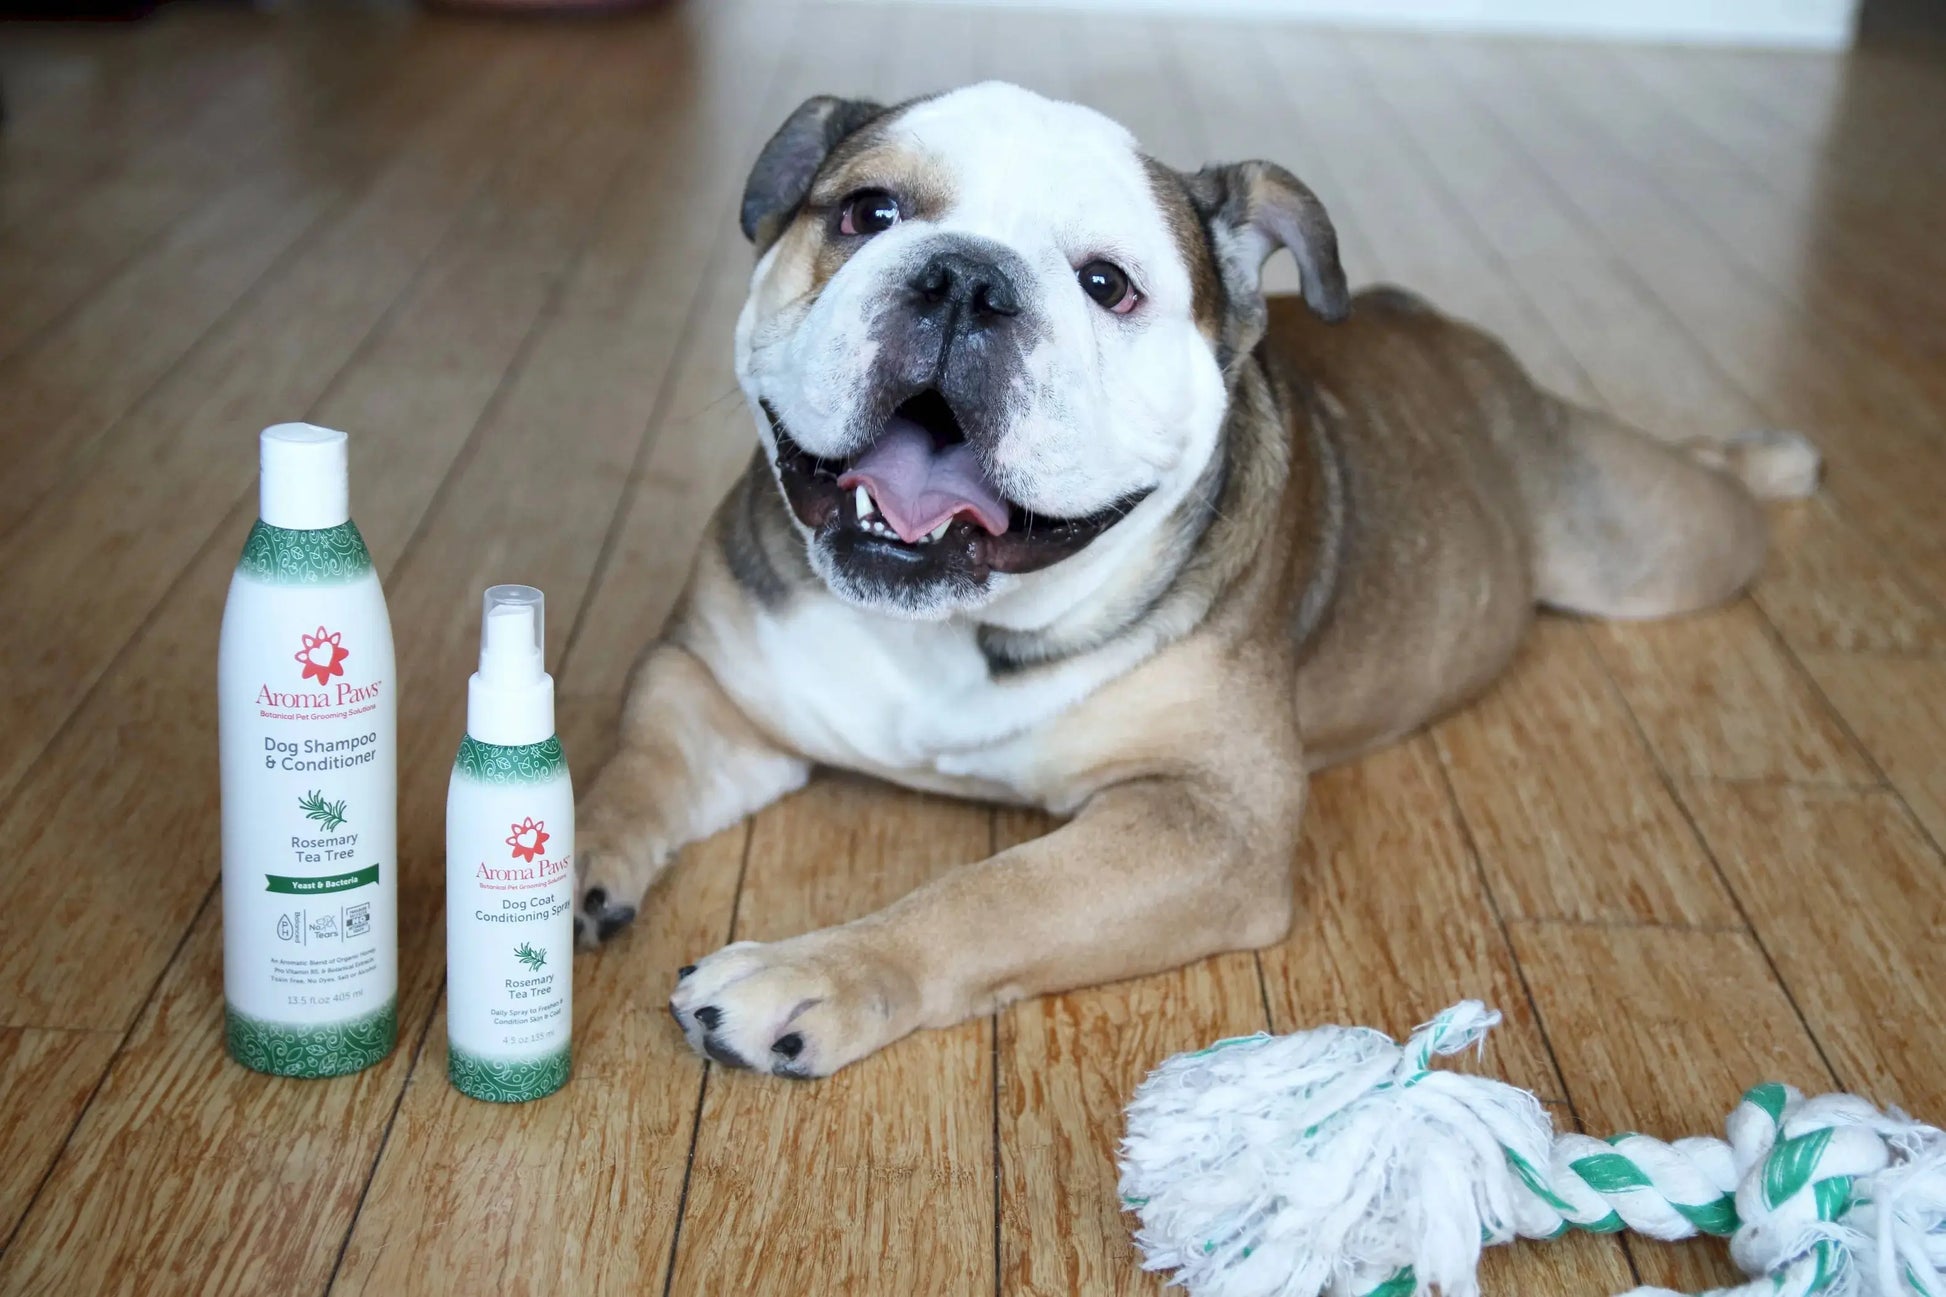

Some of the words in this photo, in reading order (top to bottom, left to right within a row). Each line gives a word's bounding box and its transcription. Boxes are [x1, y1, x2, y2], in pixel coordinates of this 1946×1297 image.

[256, 683, 331, 708] Aroma
[260, 710, 295, 720] Botanical
[311, 711, 348, 720] Grooming
[265, 737, 298, 757] Dog
[304, 732, 377, 753] Shampoo
[266, 755, 276, 769] &
[281, 749, 376, 771] Conditioner
[291, 834, 358, 848] Rosemary
[296, 851, 320, 863] Tea
[325, 849, 354, 861] Tree
[476, 862, 534, 881] Aroma
[292, 881, 316, 889] Yeast
[325, 876, 359, 888] Bacteria
[519, 881, 547, 890] Grooming
[502, 900, 527, 910] Dog
[530, 894, 554, 907] Coat
[475, 911, 549, 922] Conditioning
[551, 898, 571, 916] Spray
[314, 931, 338, 939] Tears
[505, 974, 554, 988] Rosemary
[509, 990, 528, 999] Tea
[531, 986, 552, 997] Tree
